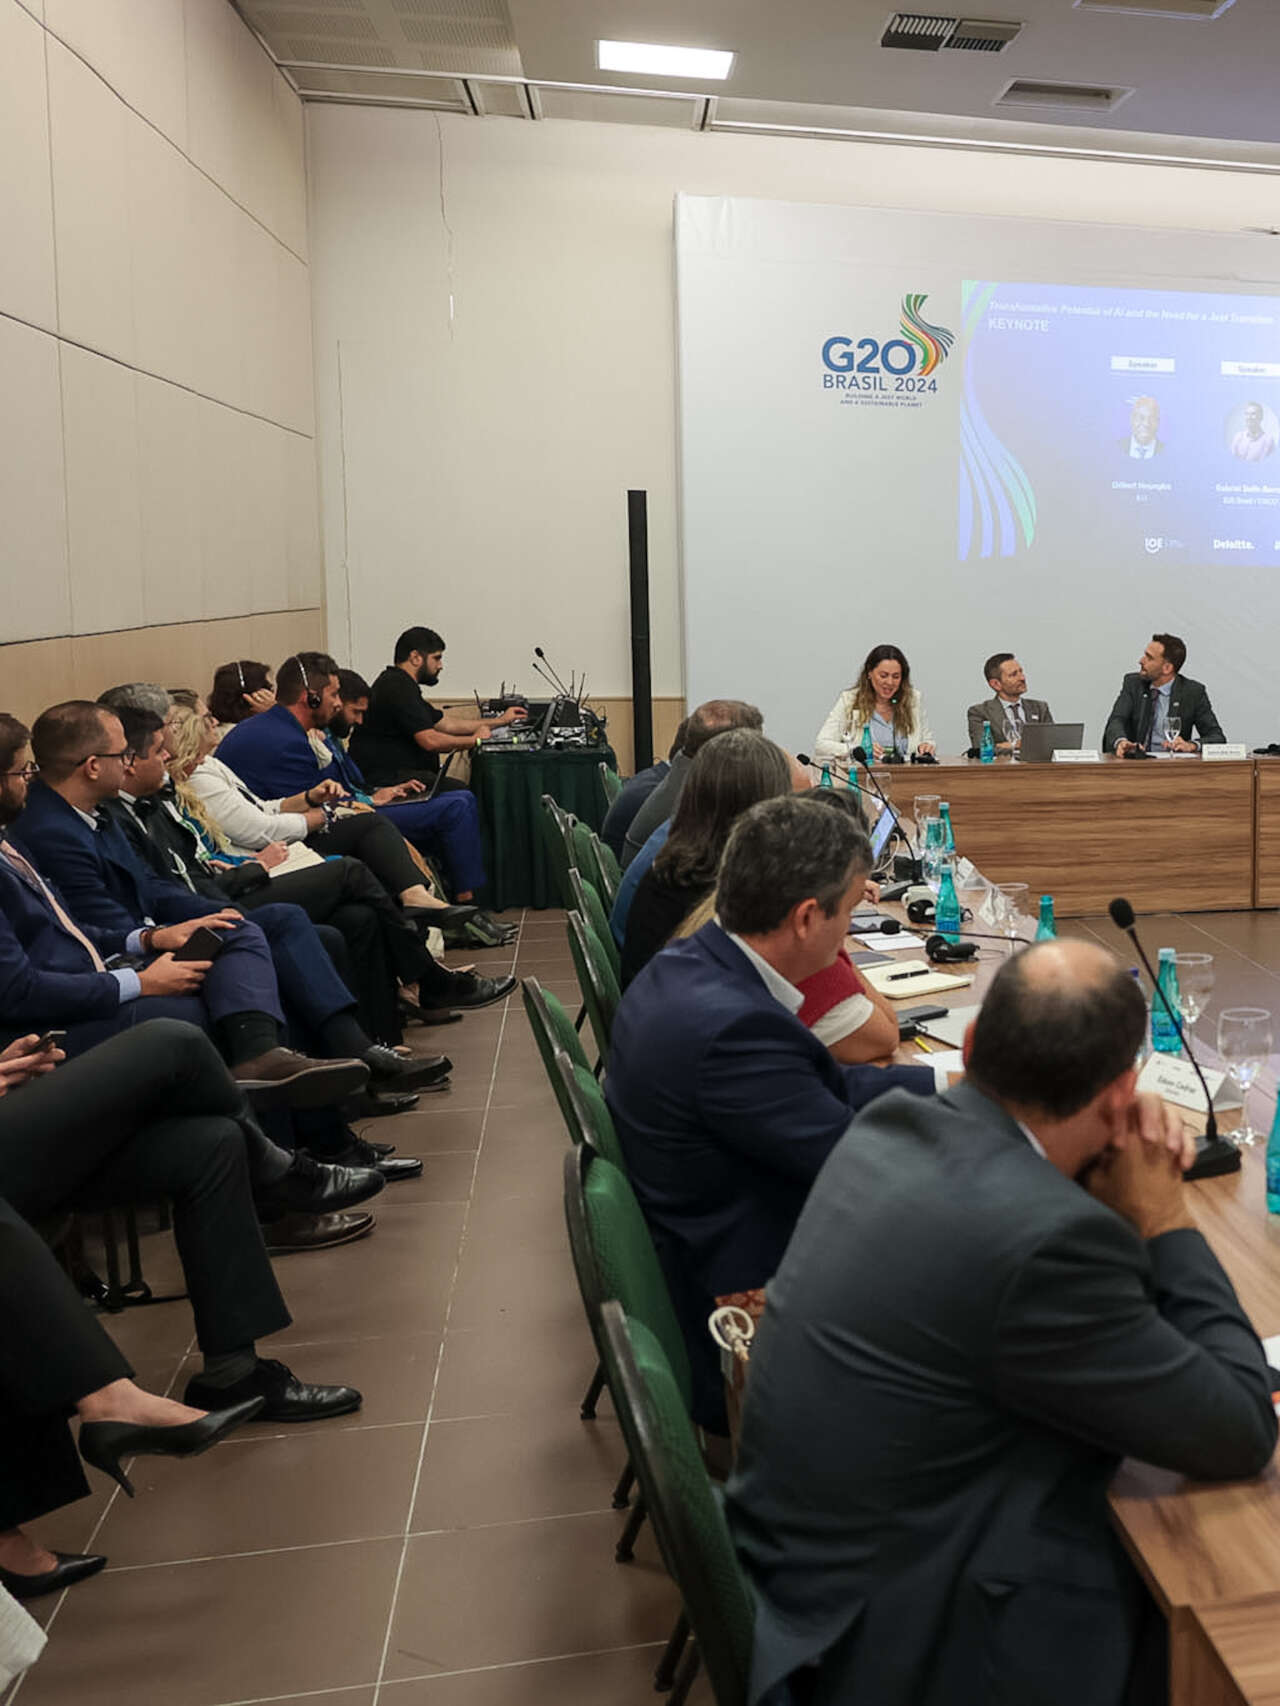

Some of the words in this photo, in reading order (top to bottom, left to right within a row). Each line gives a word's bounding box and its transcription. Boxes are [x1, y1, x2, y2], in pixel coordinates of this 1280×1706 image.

[988, 318, 1048, 332] KEYNOTE
[822, 336, 916, 375] G20
[823, 374, 888, 391] BRASIL
[895, 377, 938, 393] 2024
